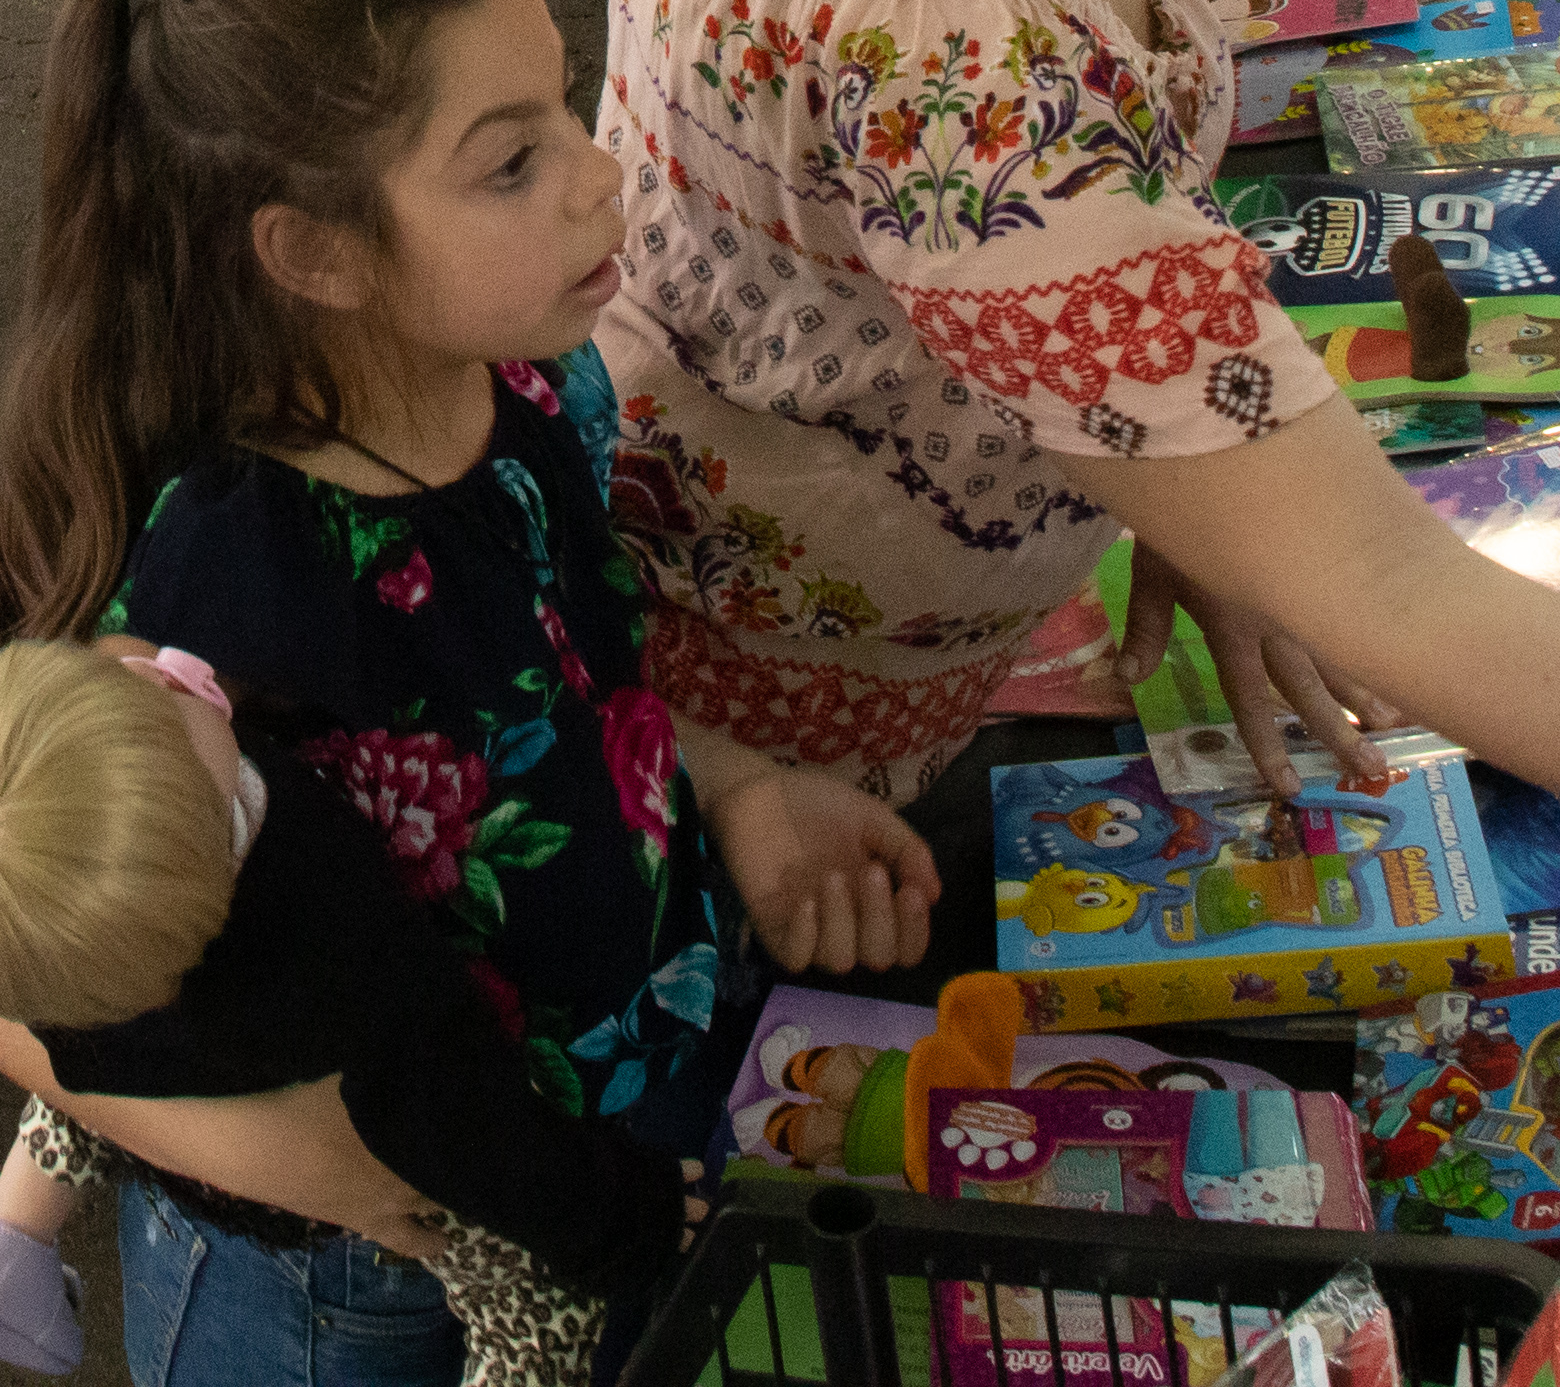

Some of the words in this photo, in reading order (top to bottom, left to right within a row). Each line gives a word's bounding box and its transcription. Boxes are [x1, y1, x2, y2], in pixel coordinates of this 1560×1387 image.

[1375, 101, 1413, 143] TIGRE
[1317, 200, 1357, 273] FUTEBOL
[1417, 192, 1496, 273] 60
[1400, 844, 1444, 926] GALINHA
[1444, 849, 1479, 923] BIBLIOTECA
